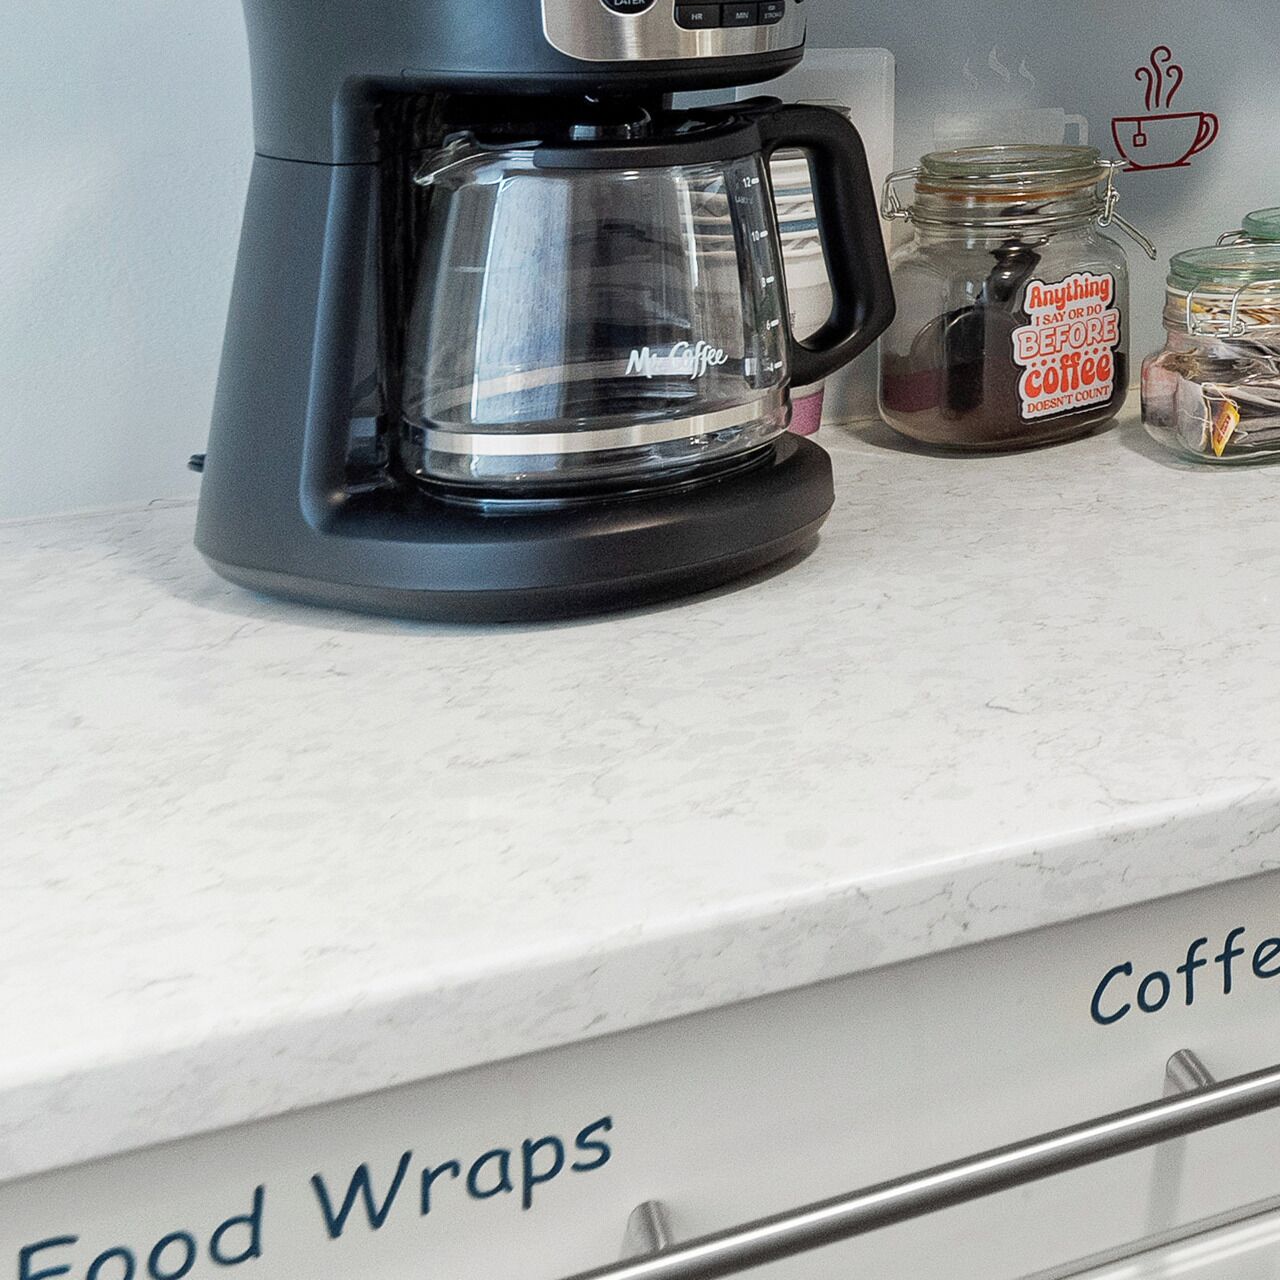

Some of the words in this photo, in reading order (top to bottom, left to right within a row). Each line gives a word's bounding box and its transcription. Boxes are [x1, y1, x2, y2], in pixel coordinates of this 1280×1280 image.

[1029, 277, 1109, 310] Anything
[1042, 311, 1066, 325] SAY
[1068, 308, 1084, 320] OR
[1087, 303, 1102, 315] DO
[1017, 313, 1117, 360] BEFORE
[668, 340, 728, 380] Coffee
[1024, 351, 1111, 398] coffee
[1027, 394, 1073, 413] DOESN'T
[1075, 385, 1110, 402] COUNT
[310, 1115, 614, 1239] Wraps
